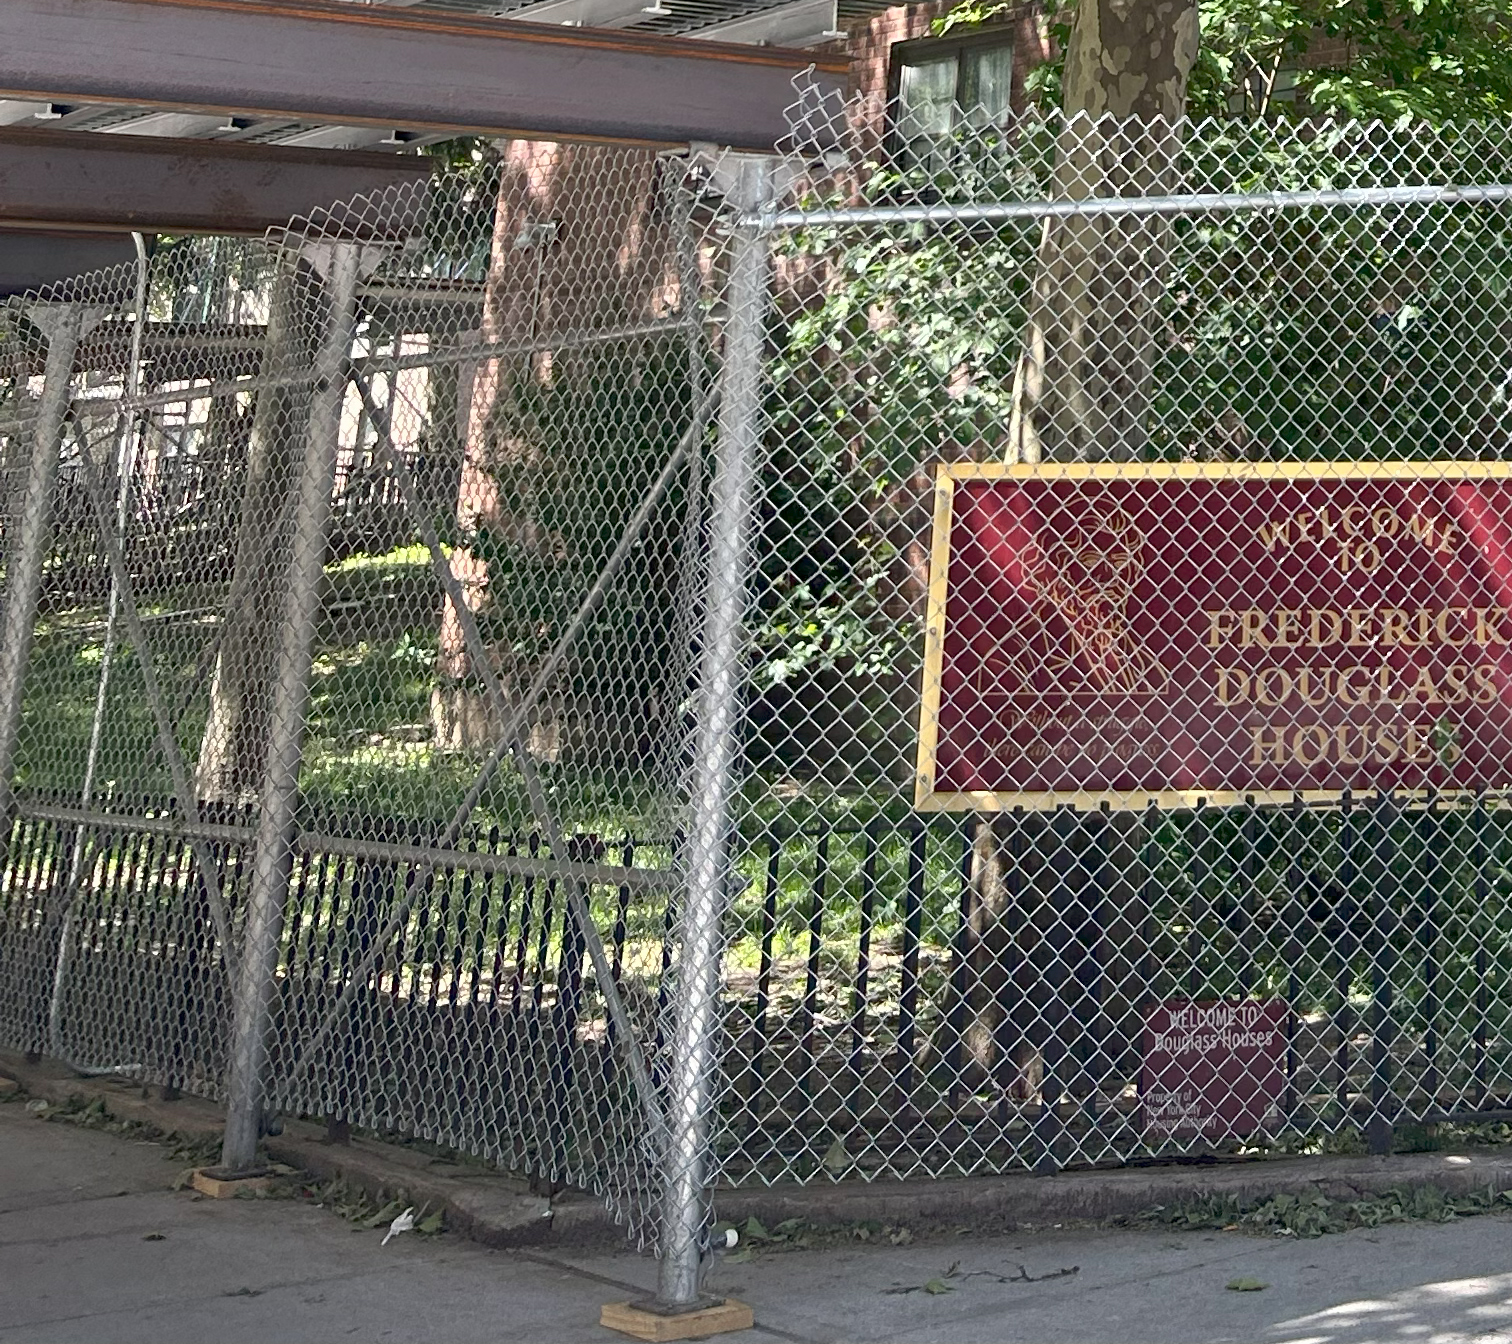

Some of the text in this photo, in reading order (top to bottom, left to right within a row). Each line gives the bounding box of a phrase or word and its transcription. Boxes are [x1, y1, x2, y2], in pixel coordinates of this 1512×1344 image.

[1259, 507, 1458, 554] WELCOME
[1336, 541, 1380, 571] TO
[1206, 608, 1509, 647] FREDERICK
[1213, 664, 1499, 706] DOUGLASS
[1169, 1006, 1258, 1028] WELCOME TO
[1154, 1029, 1273, 1055] Douglass Houses
